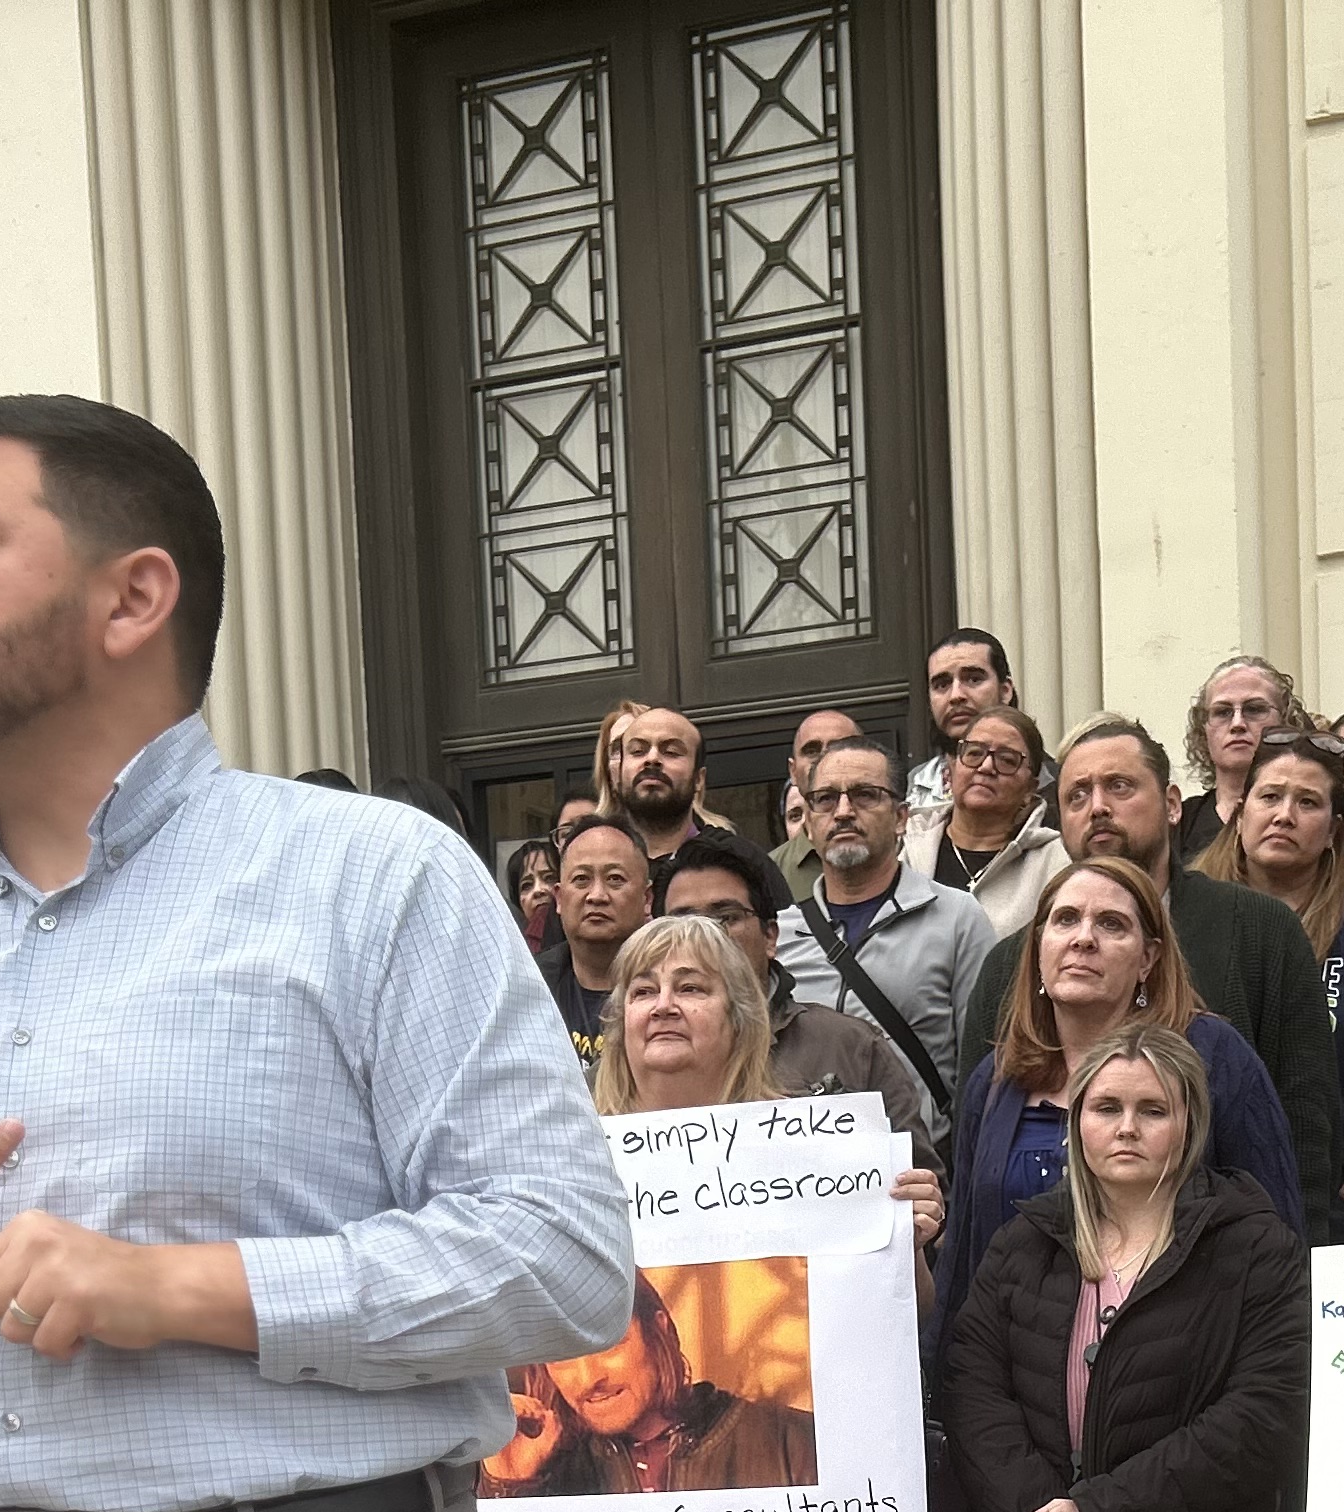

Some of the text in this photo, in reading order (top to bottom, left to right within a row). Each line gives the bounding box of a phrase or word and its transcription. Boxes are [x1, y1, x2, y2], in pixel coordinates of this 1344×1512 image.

[622, 1107, 856, 1165] simply take
[629, 1168, 883, 1220] he classroom
